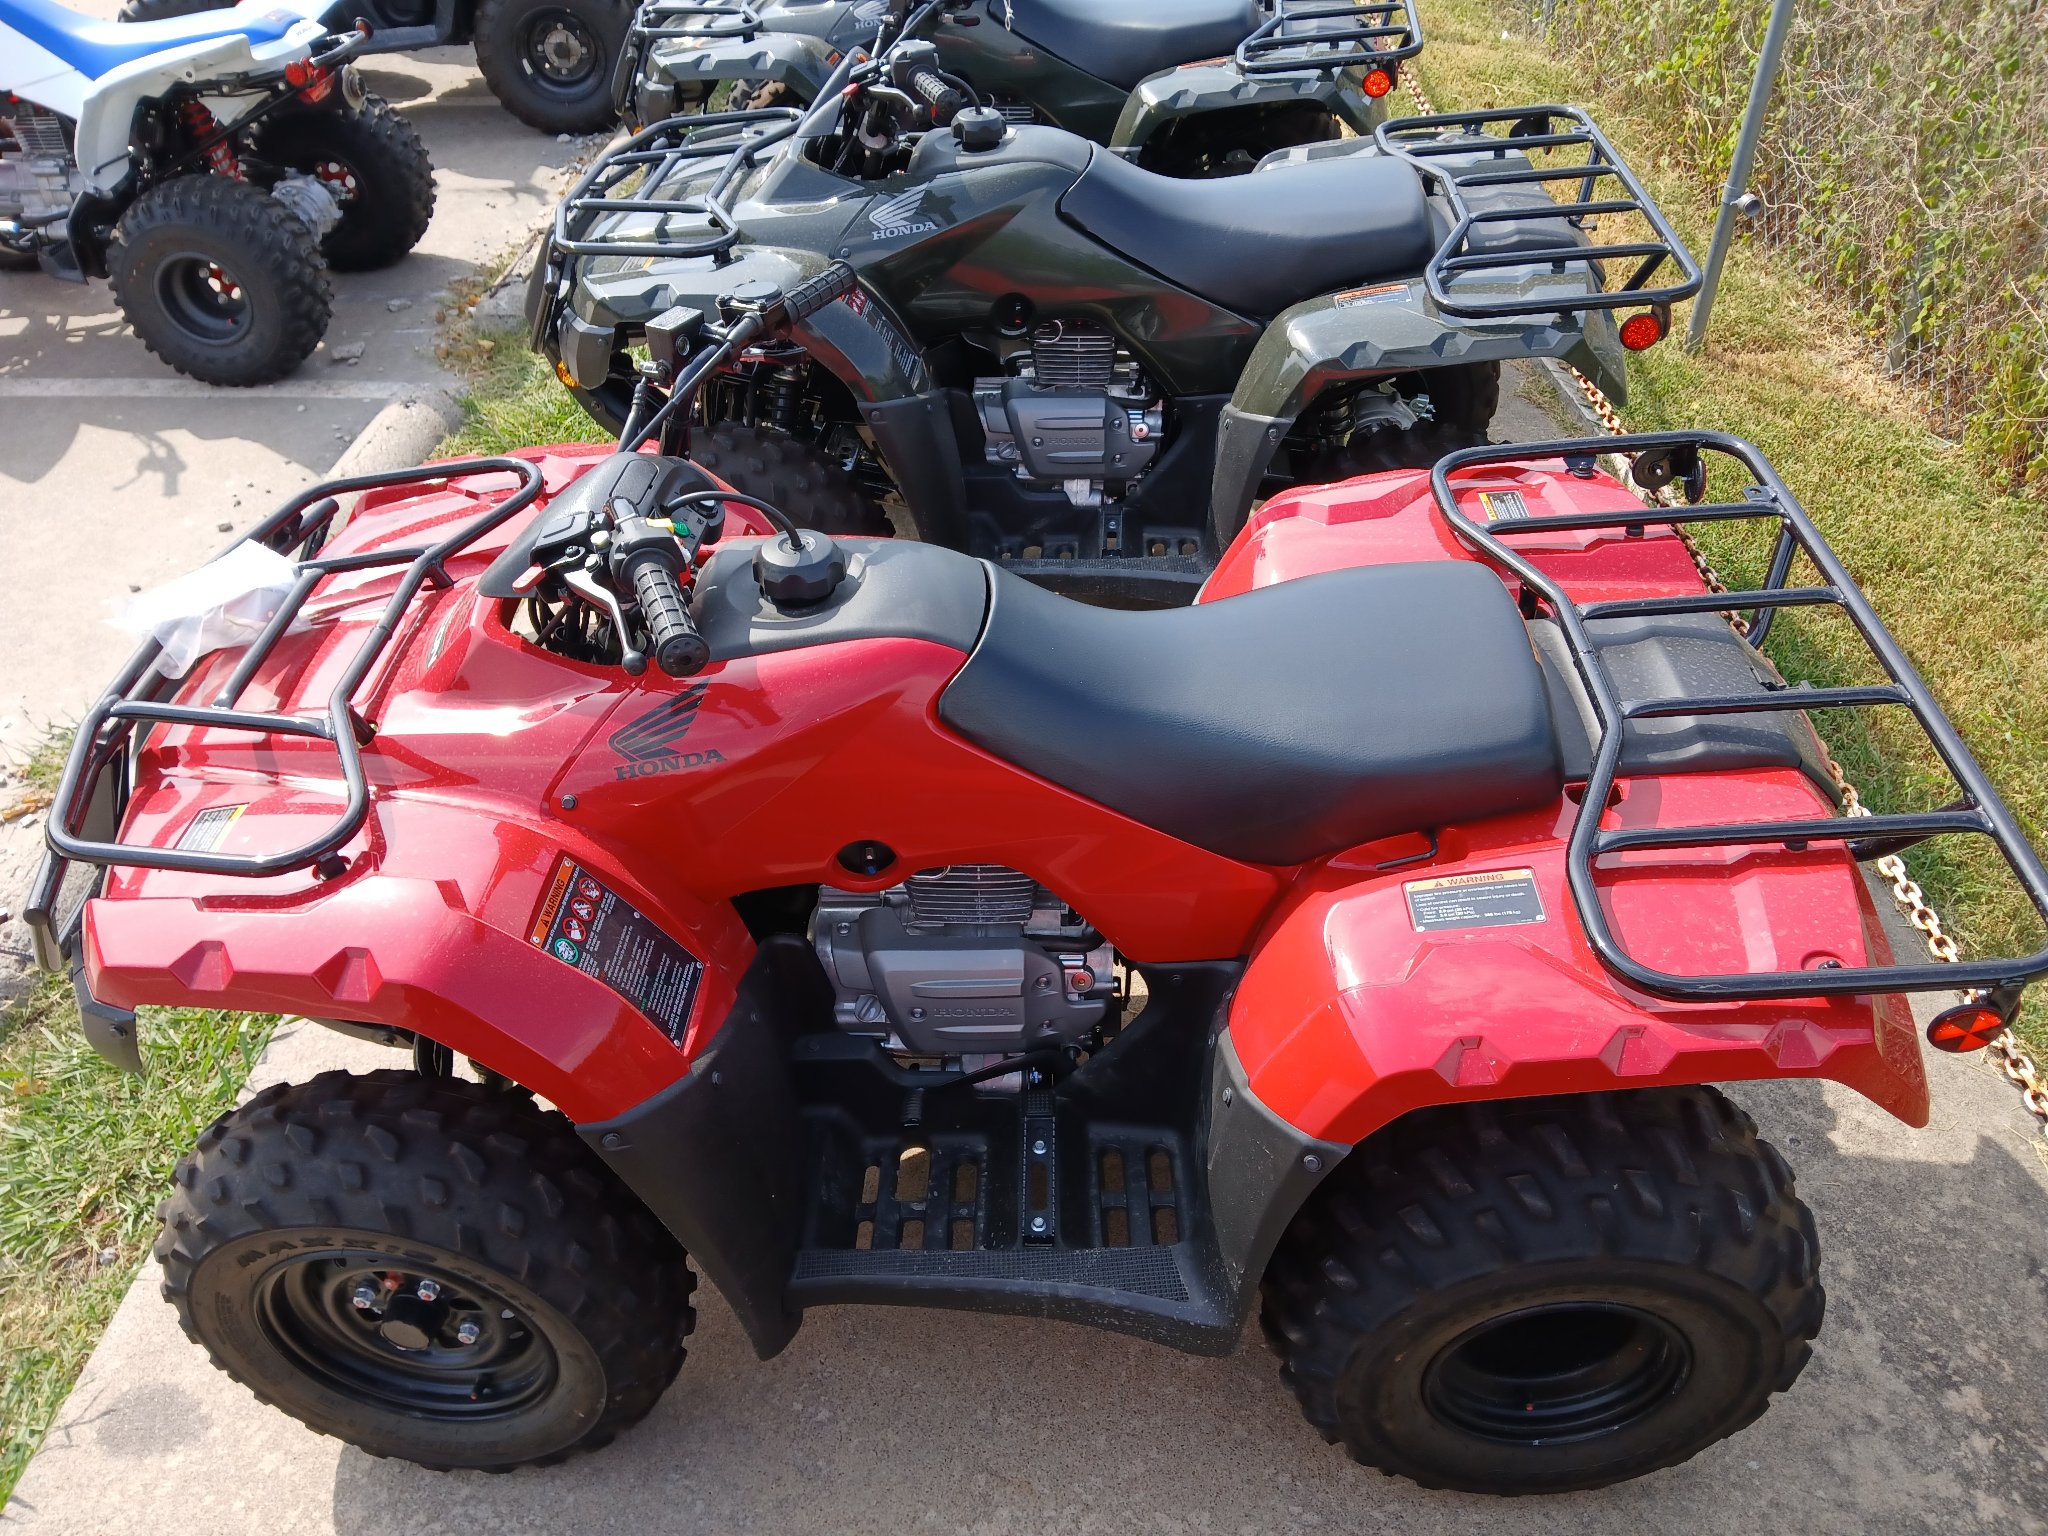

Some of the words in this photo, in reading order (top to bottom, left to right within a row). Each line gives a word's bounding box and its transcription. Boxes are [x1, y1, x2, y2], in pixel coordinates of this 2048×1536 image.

[855, 20, 882, 30] HON
[871, 221, 938, 241] HONDA
[614, 748, 727, 780] HONDA
[1447, 873, 1505, 886] WARNING
[545, 878, 565, 920] WARNING
[934, 1008, 1016, 1017] HONDA
